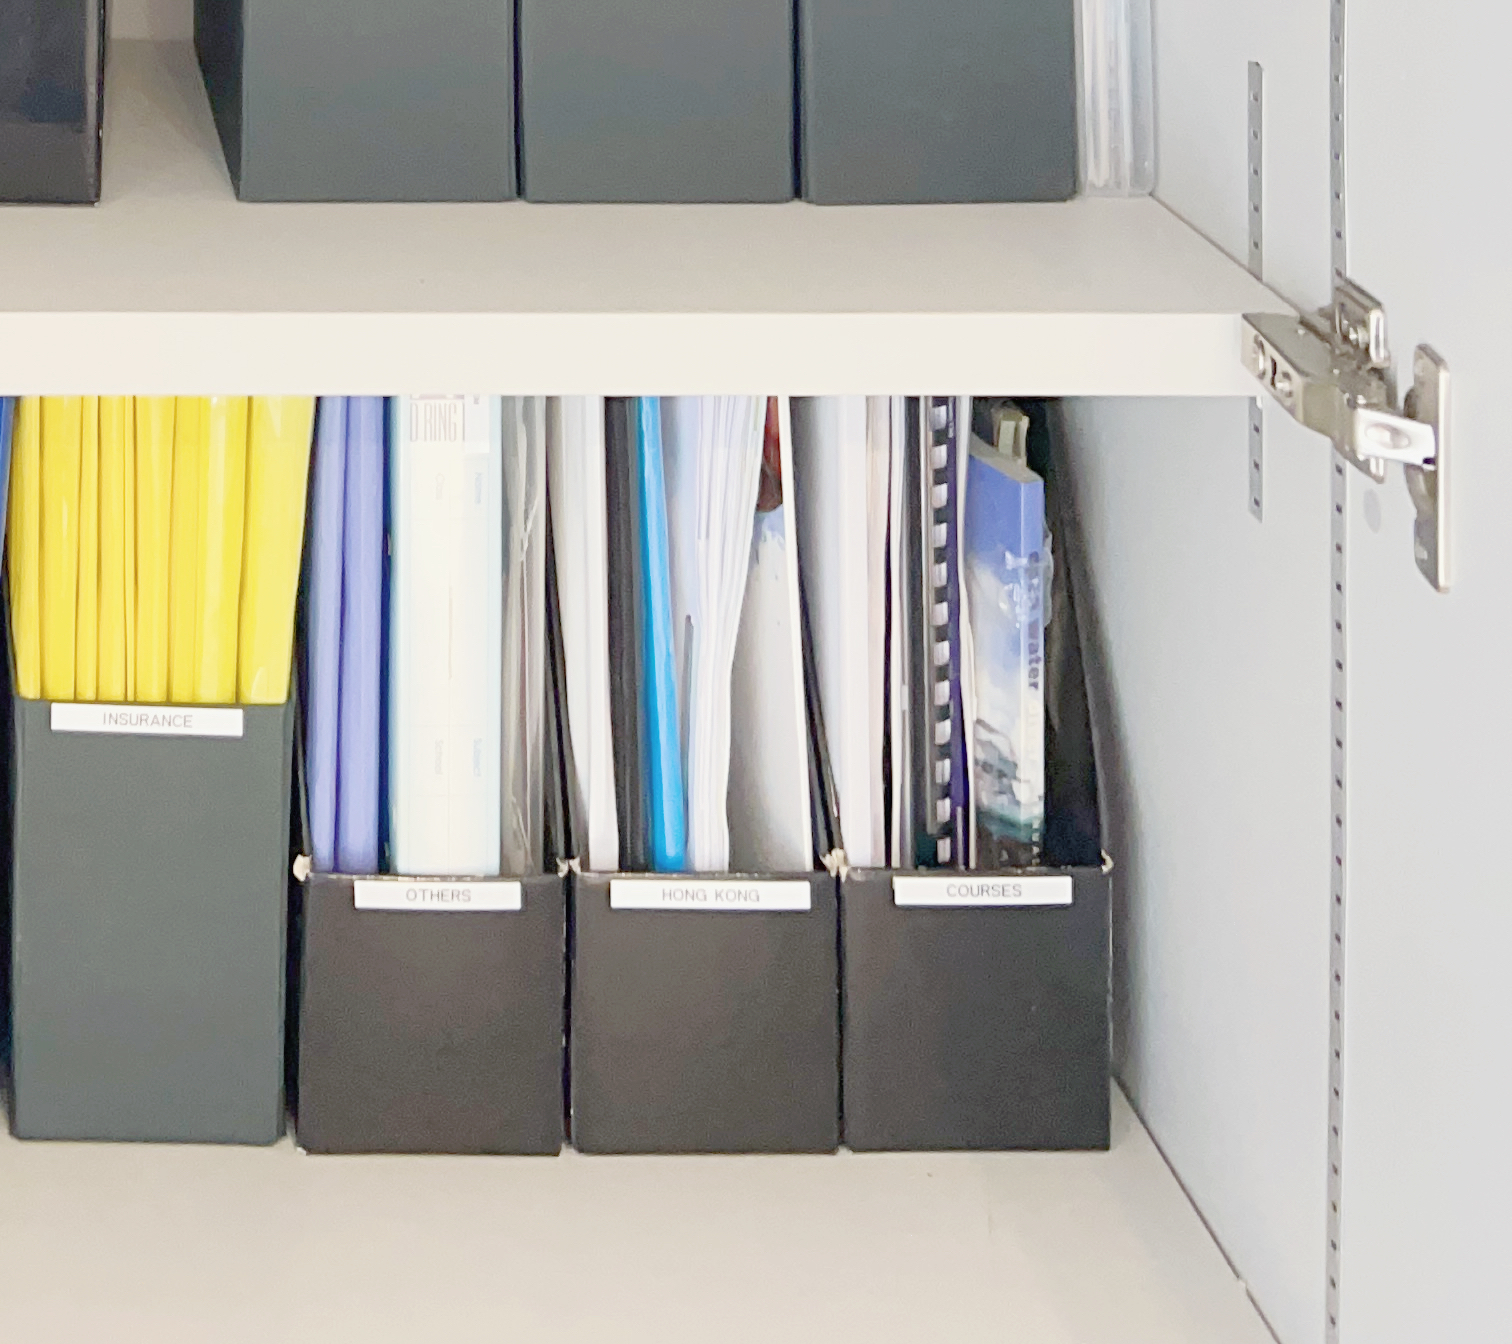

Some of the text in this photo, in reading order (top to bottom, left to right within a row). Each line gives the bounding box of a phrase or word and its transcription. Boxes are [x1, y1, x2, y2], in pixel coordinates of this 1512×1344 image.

[424, 402, 457, 443] RING
[103, 712, 193, 729] INSURANCE
[405, 888, 472, 903] OTHERS
[662, 888, 760, 903] HONG KONG
[946, 883, 1023, 898] COURSES
